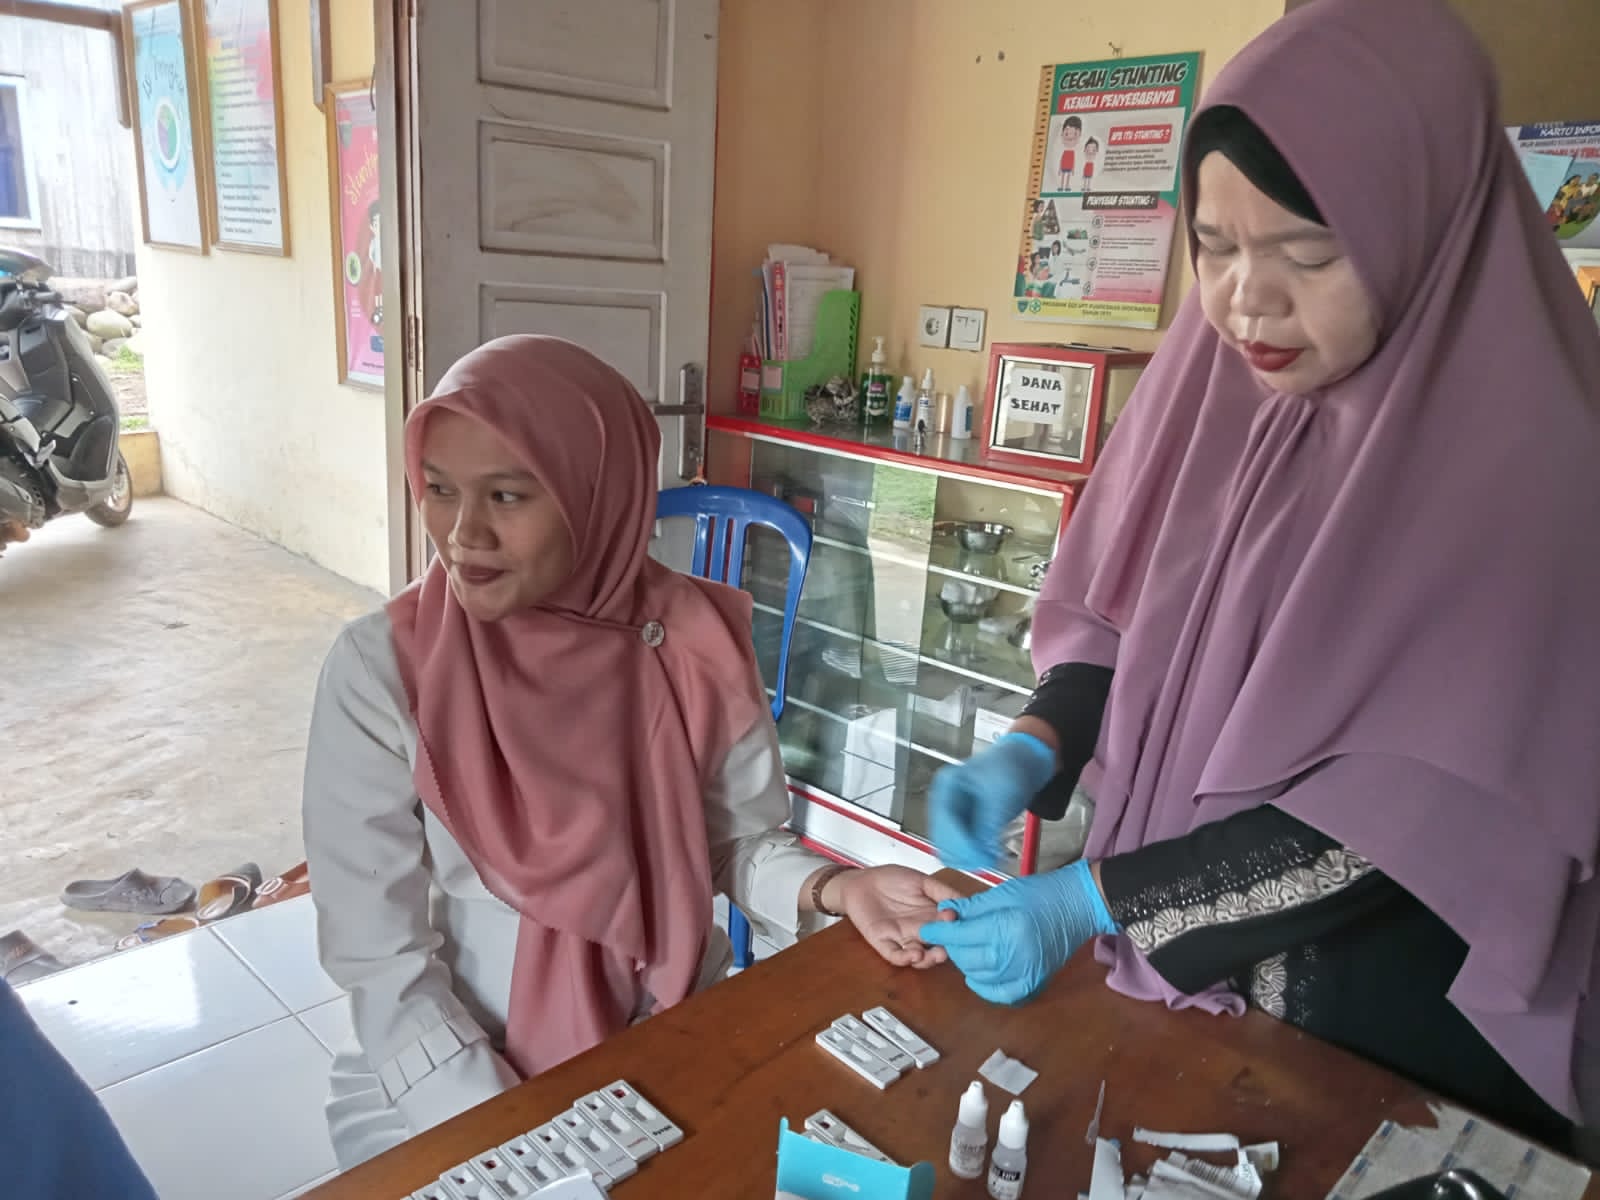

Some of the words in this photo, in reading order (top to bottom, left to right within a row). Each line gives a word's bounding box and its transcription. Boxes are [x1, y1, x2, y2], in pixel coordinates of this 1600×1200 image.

[1060, 69, 1106, 90] CEGAH
[1110, 63, 1187, 87] STUNTING
[1064, 95, 1099, 110] KENALI
[1100, 89, 1175, 107] PENYEBABNYA
[1539, 127, 1573, 137] KARTU
[1086, 195, 1118, 206] PENYEBAB
[1118, 195, 1150, 206] STUNTING
[1021, 375, 1062, 391] DANA
[1010, 397, 1061, 415] SEHAT
